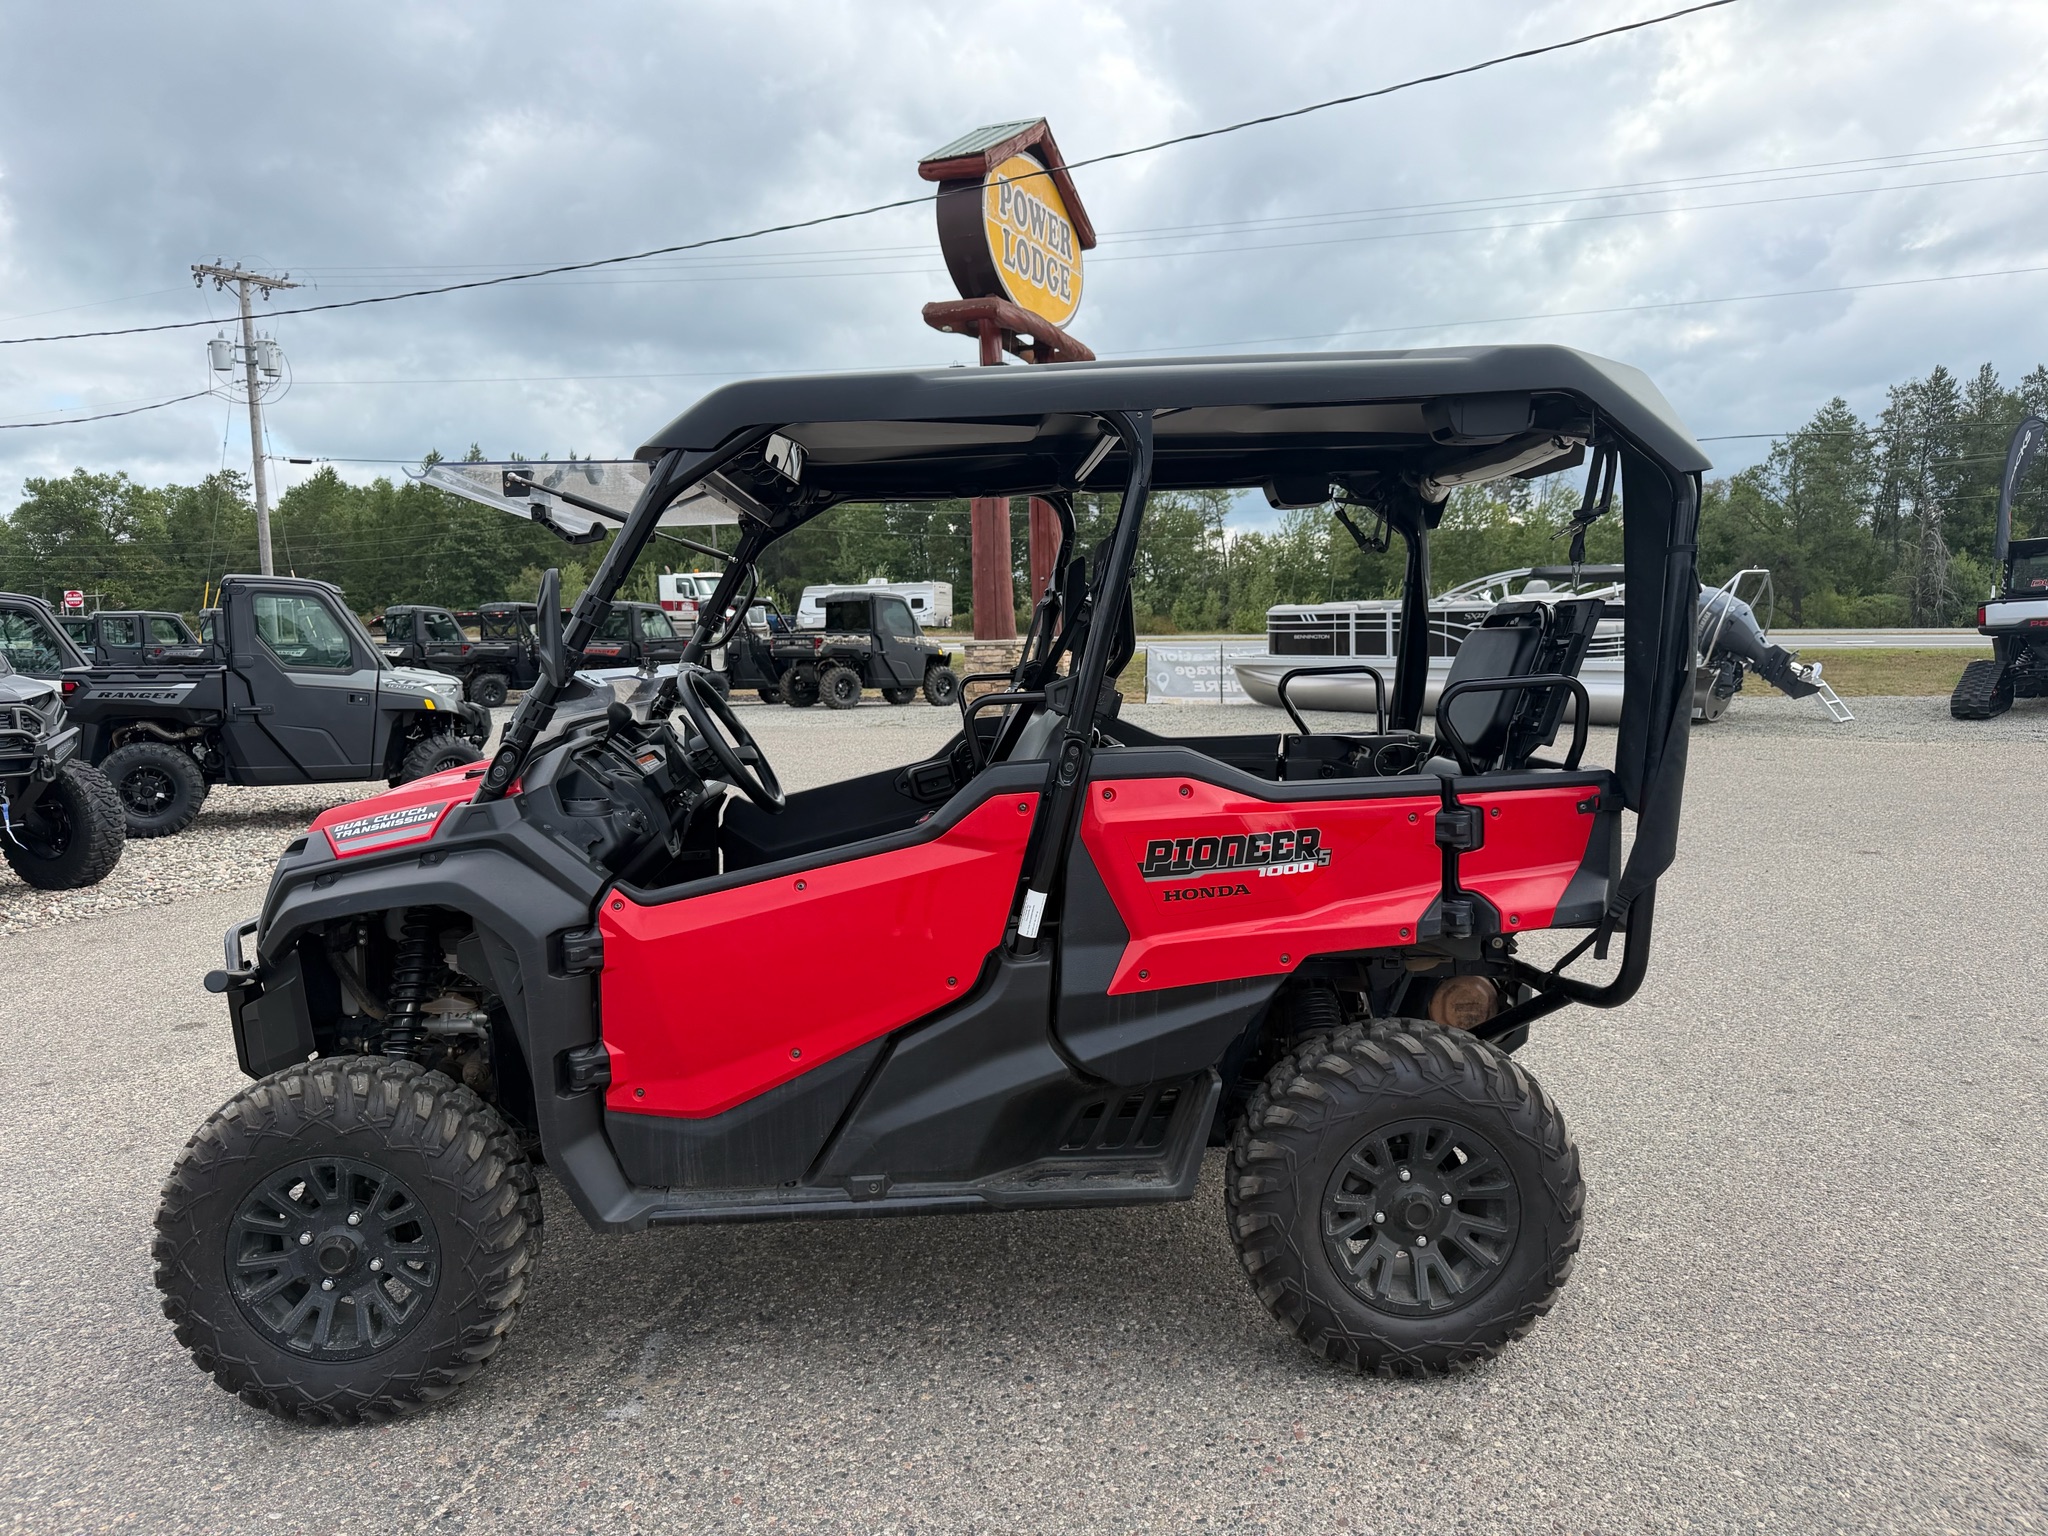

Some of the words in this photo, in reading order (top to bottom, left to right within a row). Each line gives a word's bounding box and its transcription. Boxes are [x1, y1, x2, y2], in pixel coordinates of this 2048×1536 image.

[997, 174, 1073, 263] POWER
[1001, 227, 1072, 304] LODGE
[97, 691, 178, 699] RANGER
[334, 820, 369, 833] DUAL
[373, 806, 428, 824] CLUTCH
[335, 811, 438, 839] TRANSMISSION
[1143, 827, 1321, 873] PIONEER
[1258, 862, 1315, 877] 1000
[1163, 884, 1251, 902] HONDA
